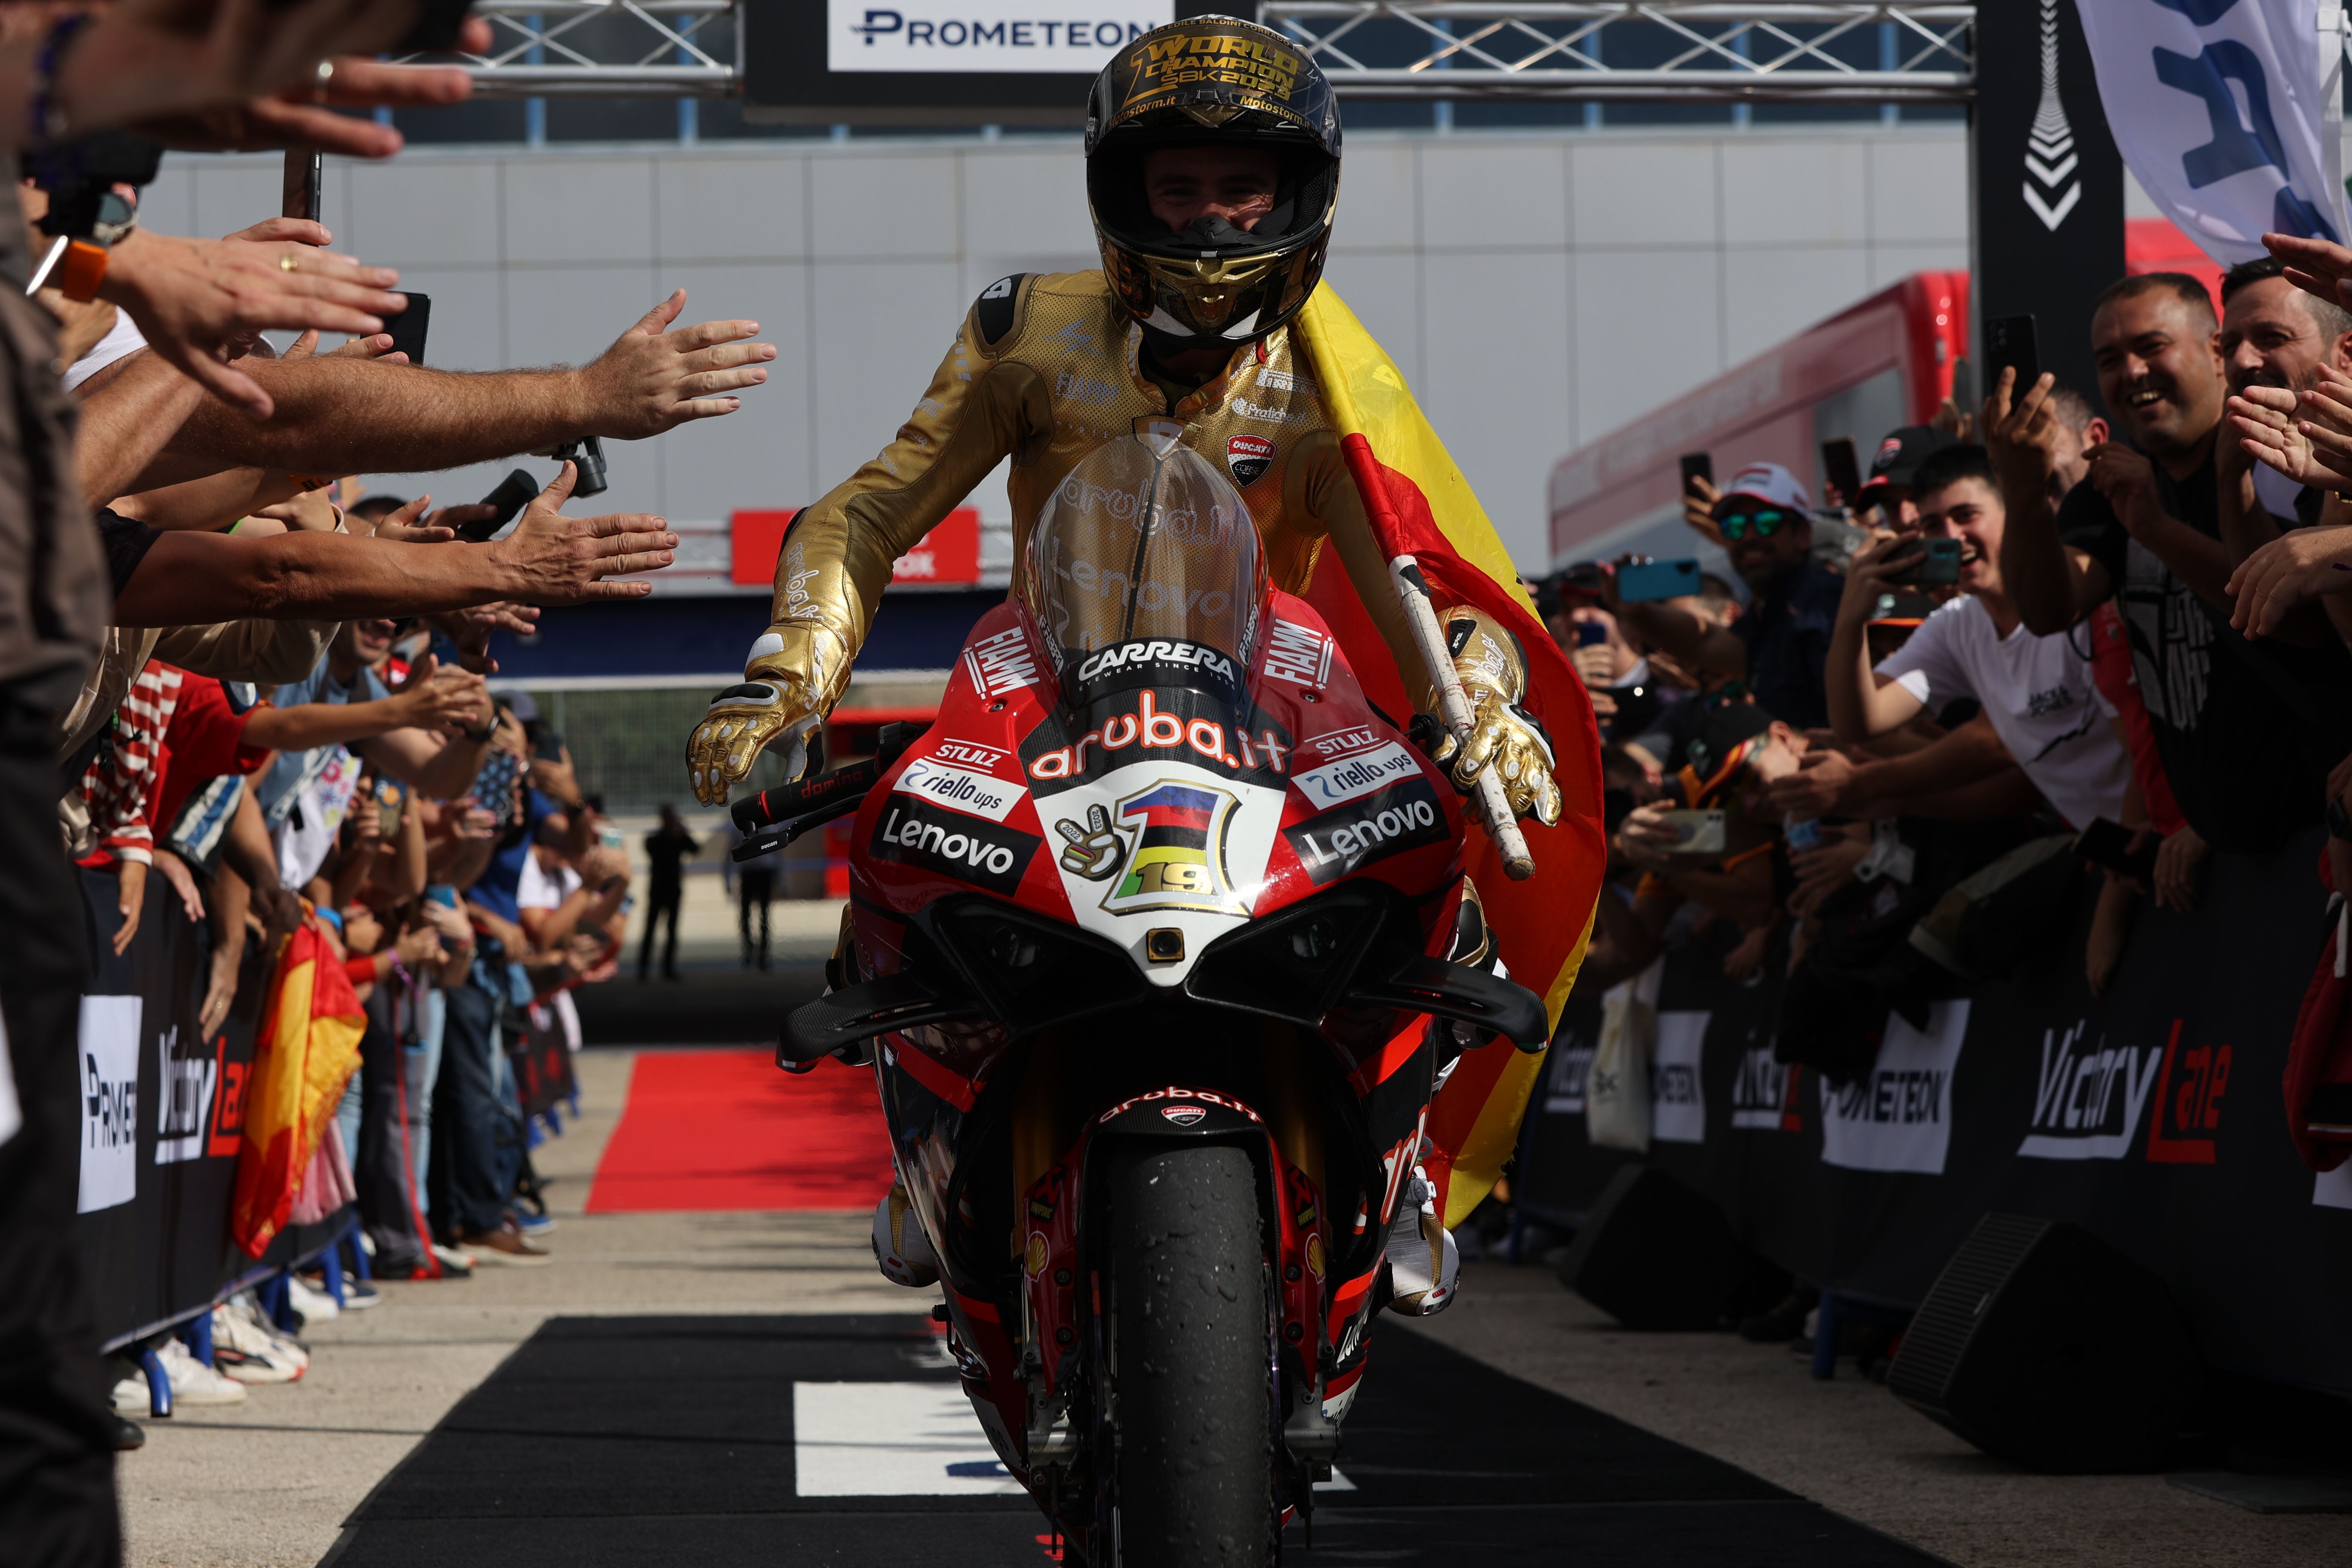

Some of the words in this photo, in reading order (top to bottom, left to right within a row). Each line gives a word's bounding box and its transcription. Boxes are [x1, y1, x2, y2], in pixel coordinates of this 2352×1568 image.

[1167, 19, 1197, 29] EDILE
[1199, 19, 1241, 27] BALDINI
[1243, 23, 1290, 46] CORRADO
[1145, 55, 1295, 89] CHAMPION
[1147, 35, 1299, 75] WORLD
[1107, 95, 1176, 128] Motostorm.it
[1240, 95, 1311, 129] Motostorm.it
[1056, 372, 1118, 403] FIAMM
[1232, 441, 1271, 454] DUCATI
[1235, 463, 1261, 474] CORSE
[1050, 536, 1230, 617] Lenovo
[974, 626, 1040, 696] FIAMM
[1078, 642, 1235, 682] CARRERA
[1264, 618, 1323, 687] FIAMM
[1078, 664, 1143, 692] EYEWEAR
[1155, 662, 1200, 673] SINCE
[1210, 672, 1235, 690] 1956
[1029, 689, 1289, 780] aruba.it
[1315, 730, 1379, 754] STULZ
[935, 744, 1002, 767] STULZ
[1333, 763, 1384, 792] riello
[1386, 752, 1412, 774] ups
[801, 770, 864, 799] domino
[922, 773, 972, 800] riello
[973, 787, 1002, 809] ups
[1062, 824, 1081, 840] 2022
[1092, 809, 1102, 830] 2023
[1302, 799, 1434, 865] Lenovo
[761, 841, 778, 850] DUCATI
[882, 808, 1014, 874] Lenovo
[1136, 861, 1214, 895] 19
